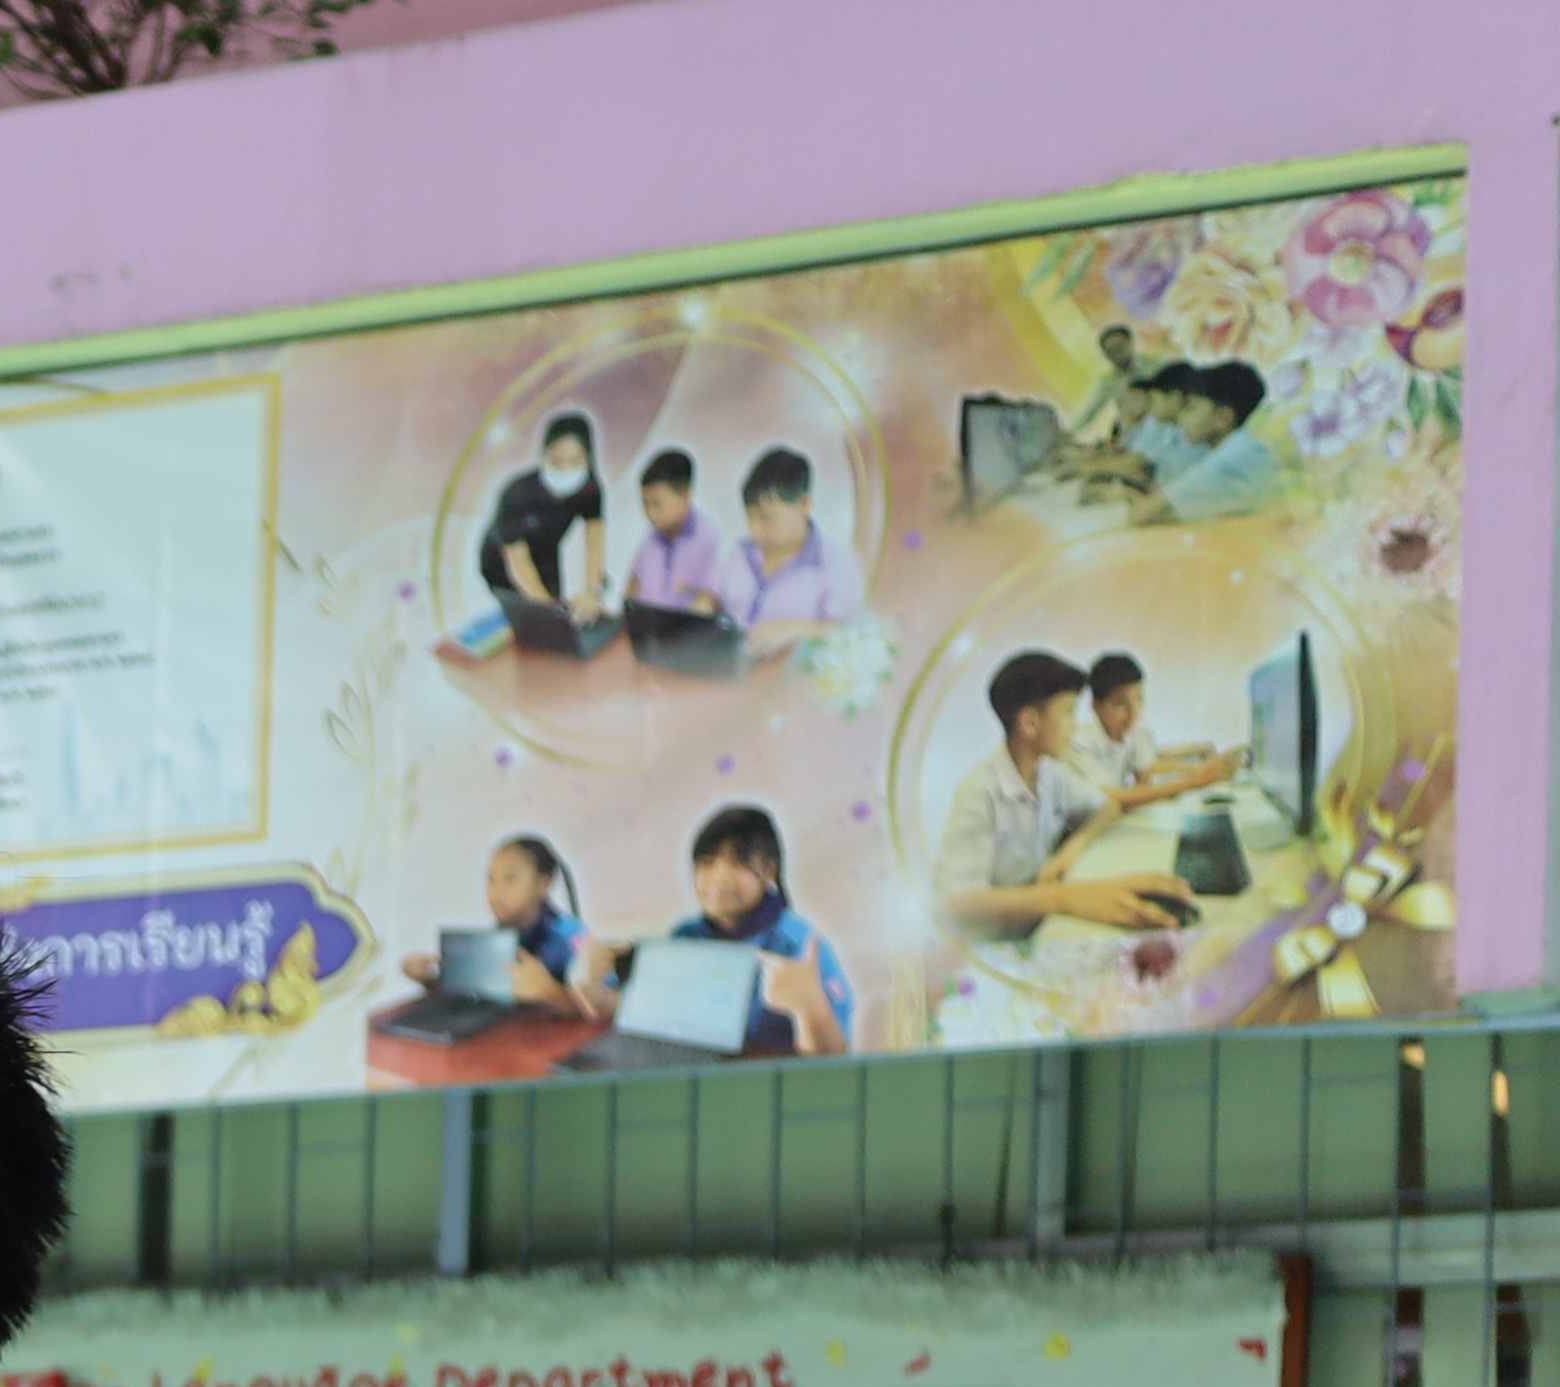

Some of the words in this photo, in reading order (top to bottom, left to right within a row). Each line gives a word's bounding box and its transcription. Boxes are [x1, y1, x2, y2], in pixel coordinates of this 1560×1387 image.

[6, 898, 276, 981] การเรียนรู้
